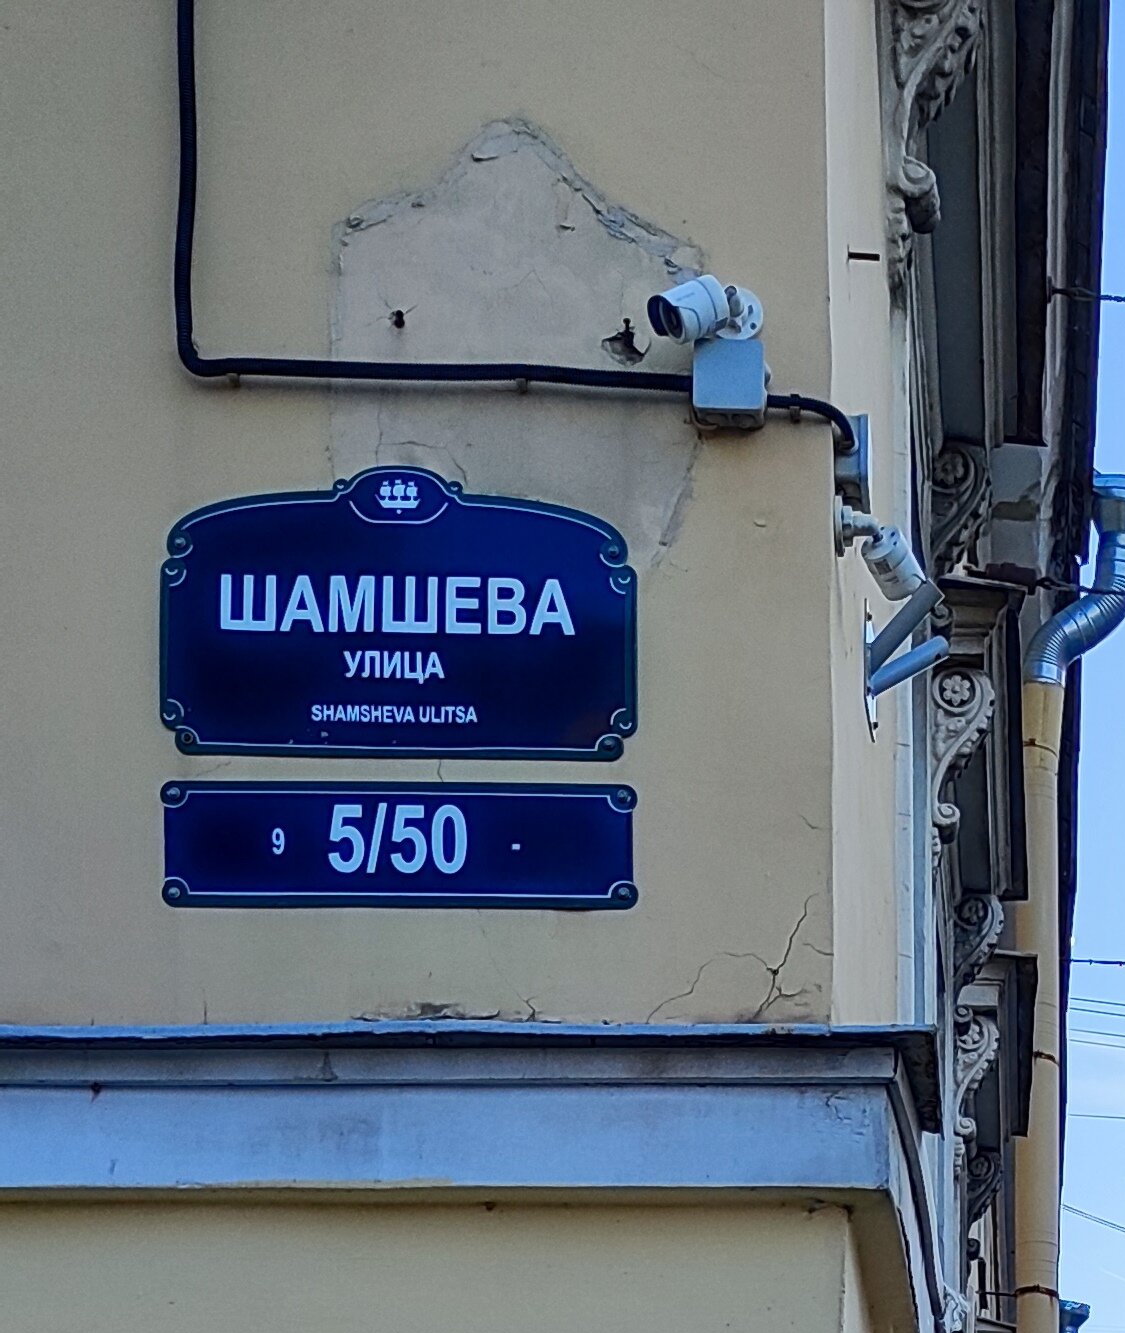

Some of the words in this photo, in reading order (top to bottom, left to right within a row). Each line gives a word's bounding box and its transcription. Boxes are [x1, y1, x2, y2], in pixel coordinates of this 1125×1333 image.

[220, 574, 576, 636] ШАМШЕВА
[343, 650, 445, 684] УЛИЦА
[311, 704, 415, 723] SHAMSHEVA
[419, 705, 478, 723] ULITSA
[272, 828, 285, 855] 9
[328, 803, 468, 874] 5/50
